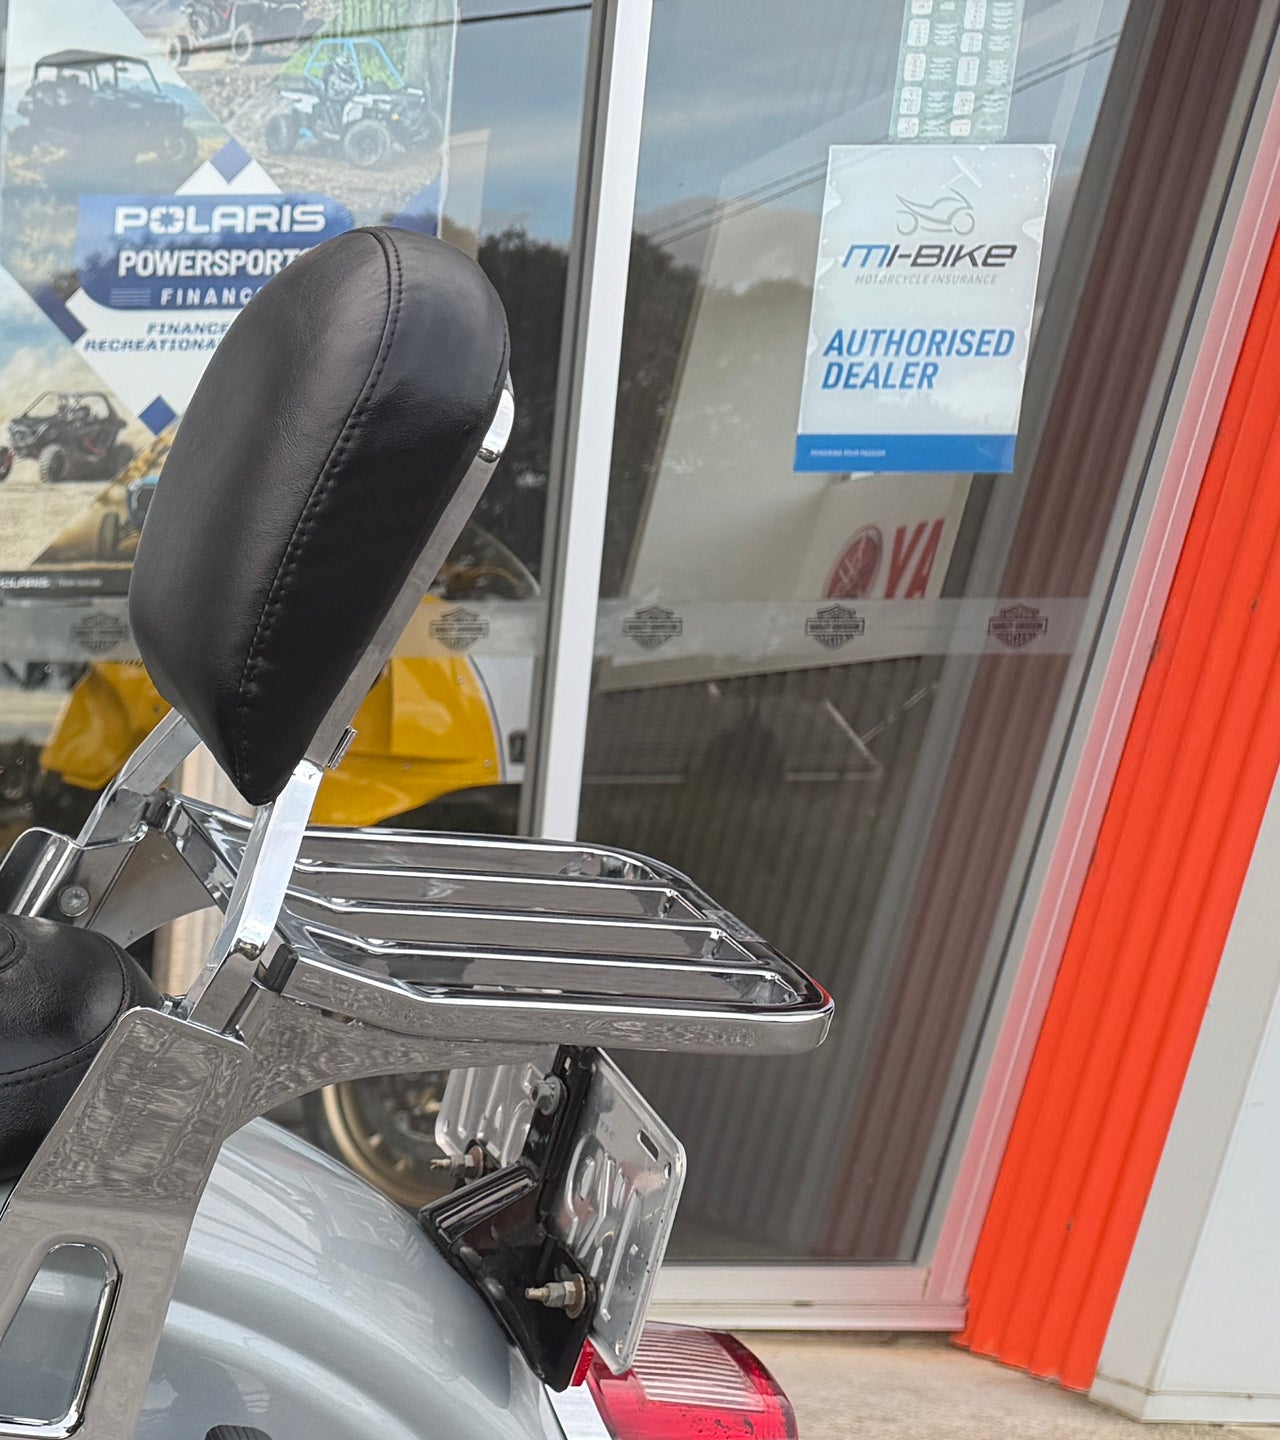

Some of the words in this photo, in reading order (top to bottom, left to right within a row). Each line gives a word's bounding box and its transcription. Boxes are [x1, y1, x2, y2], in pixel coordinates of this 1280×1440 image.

[113, 204, 327, 235] POLARIS
[117, 248, 312, 278] POWERSPORT
[855, 273, 929, 285] MOTORCYCLE
[931, 272, 998, 285] INSURANCE
[160, 286, 261, 306] FINANC
[84, 337, 218, 352] RECREATIONA
[823, 329, 1015, 357] AUTHORISED
[822, 362, 939, 390] DEALER
